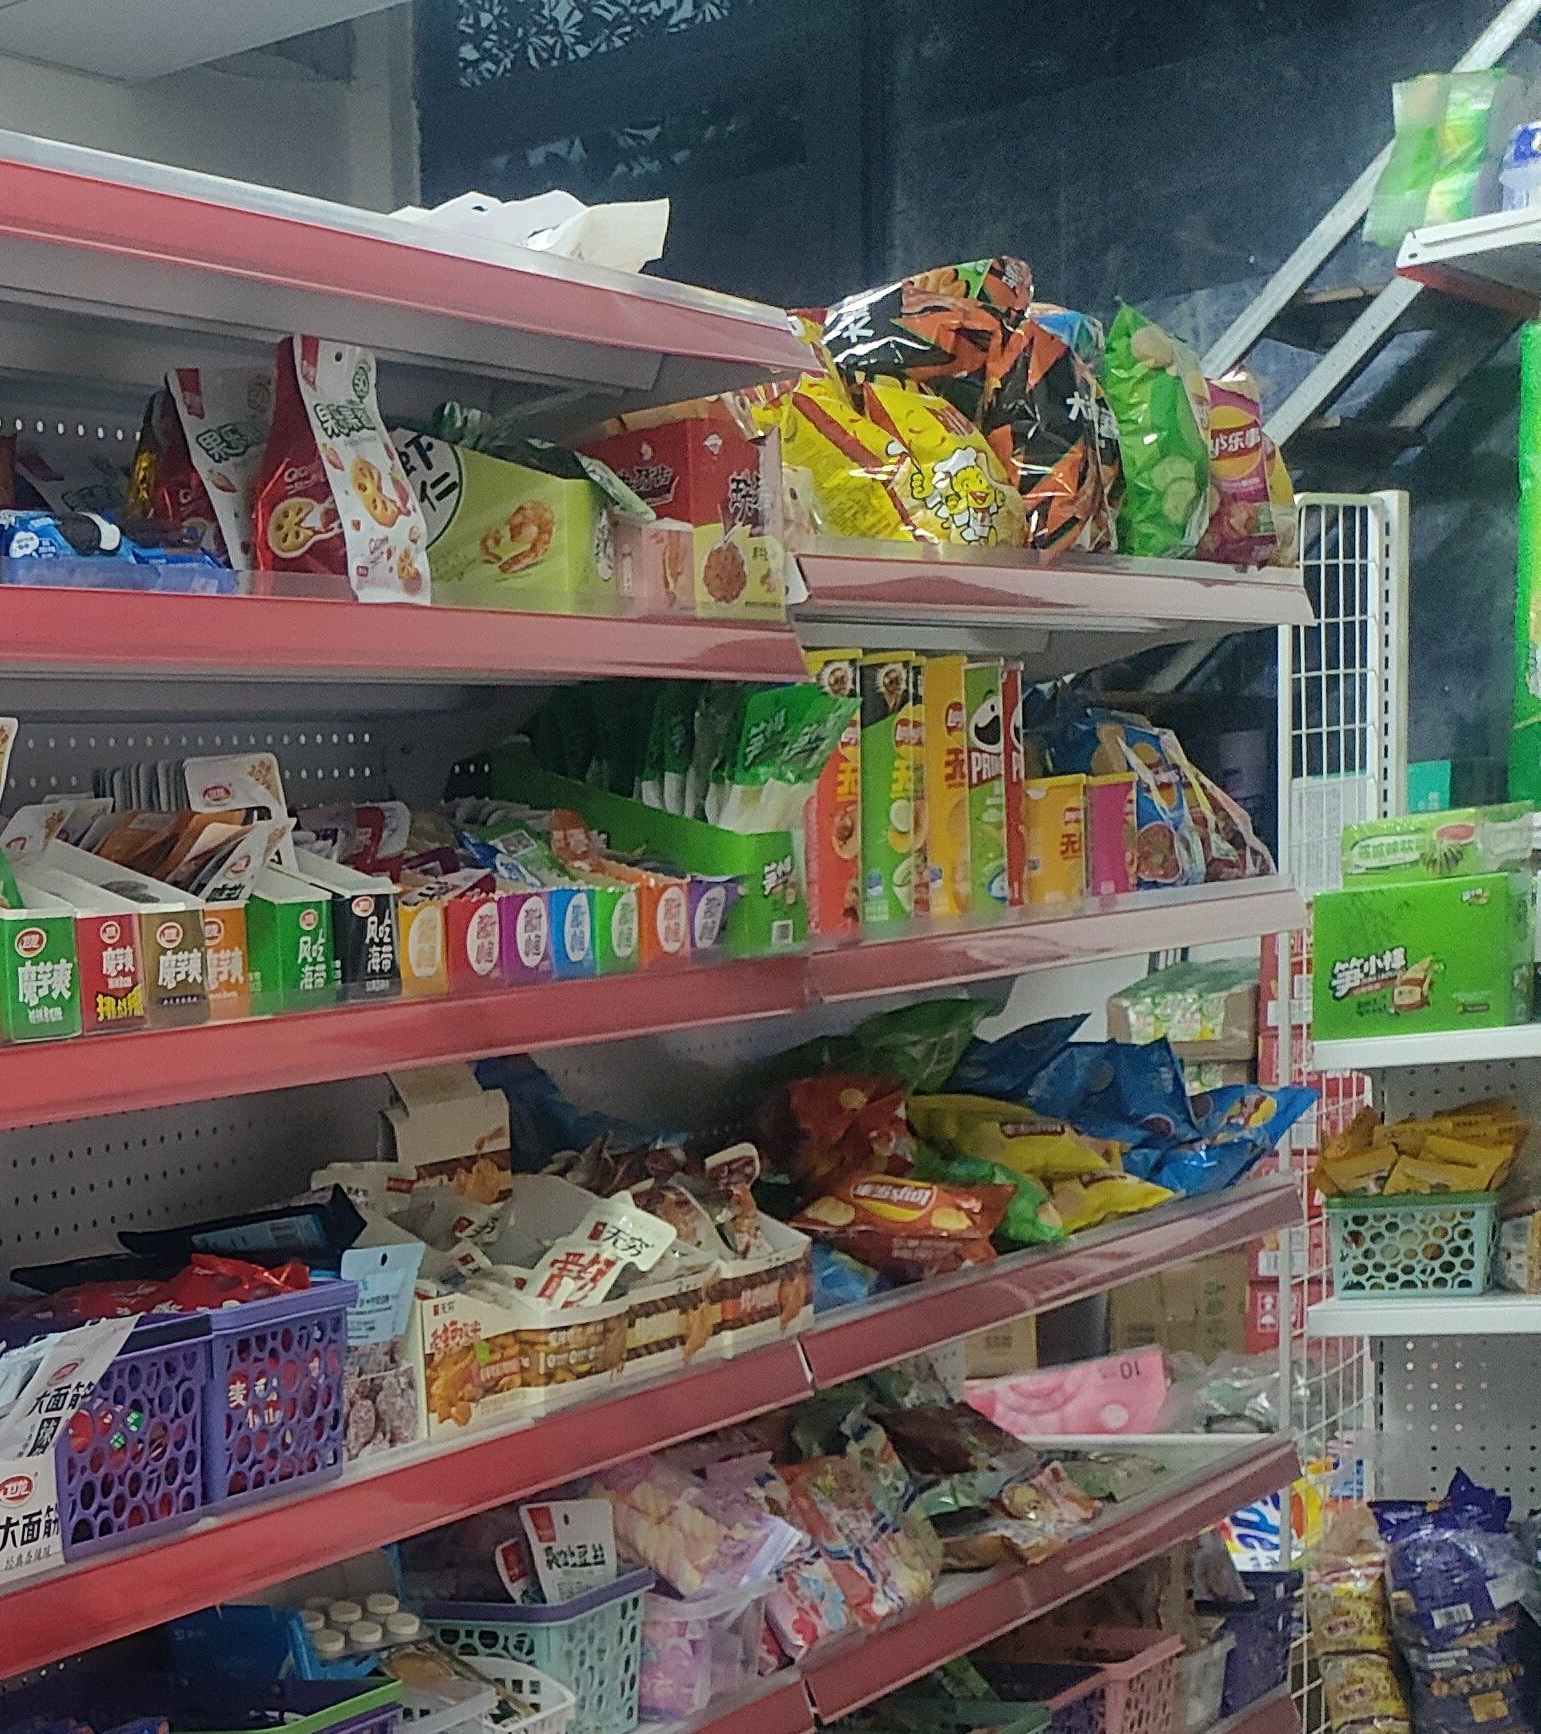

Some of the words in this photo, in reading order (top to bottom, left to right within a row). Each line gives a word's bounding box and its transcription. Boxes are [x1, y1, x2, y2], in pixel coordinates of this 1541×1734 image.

[17, 959, 73, 1005] 魔芋爽
[158, 948, 204, 988] 魔芋爽
